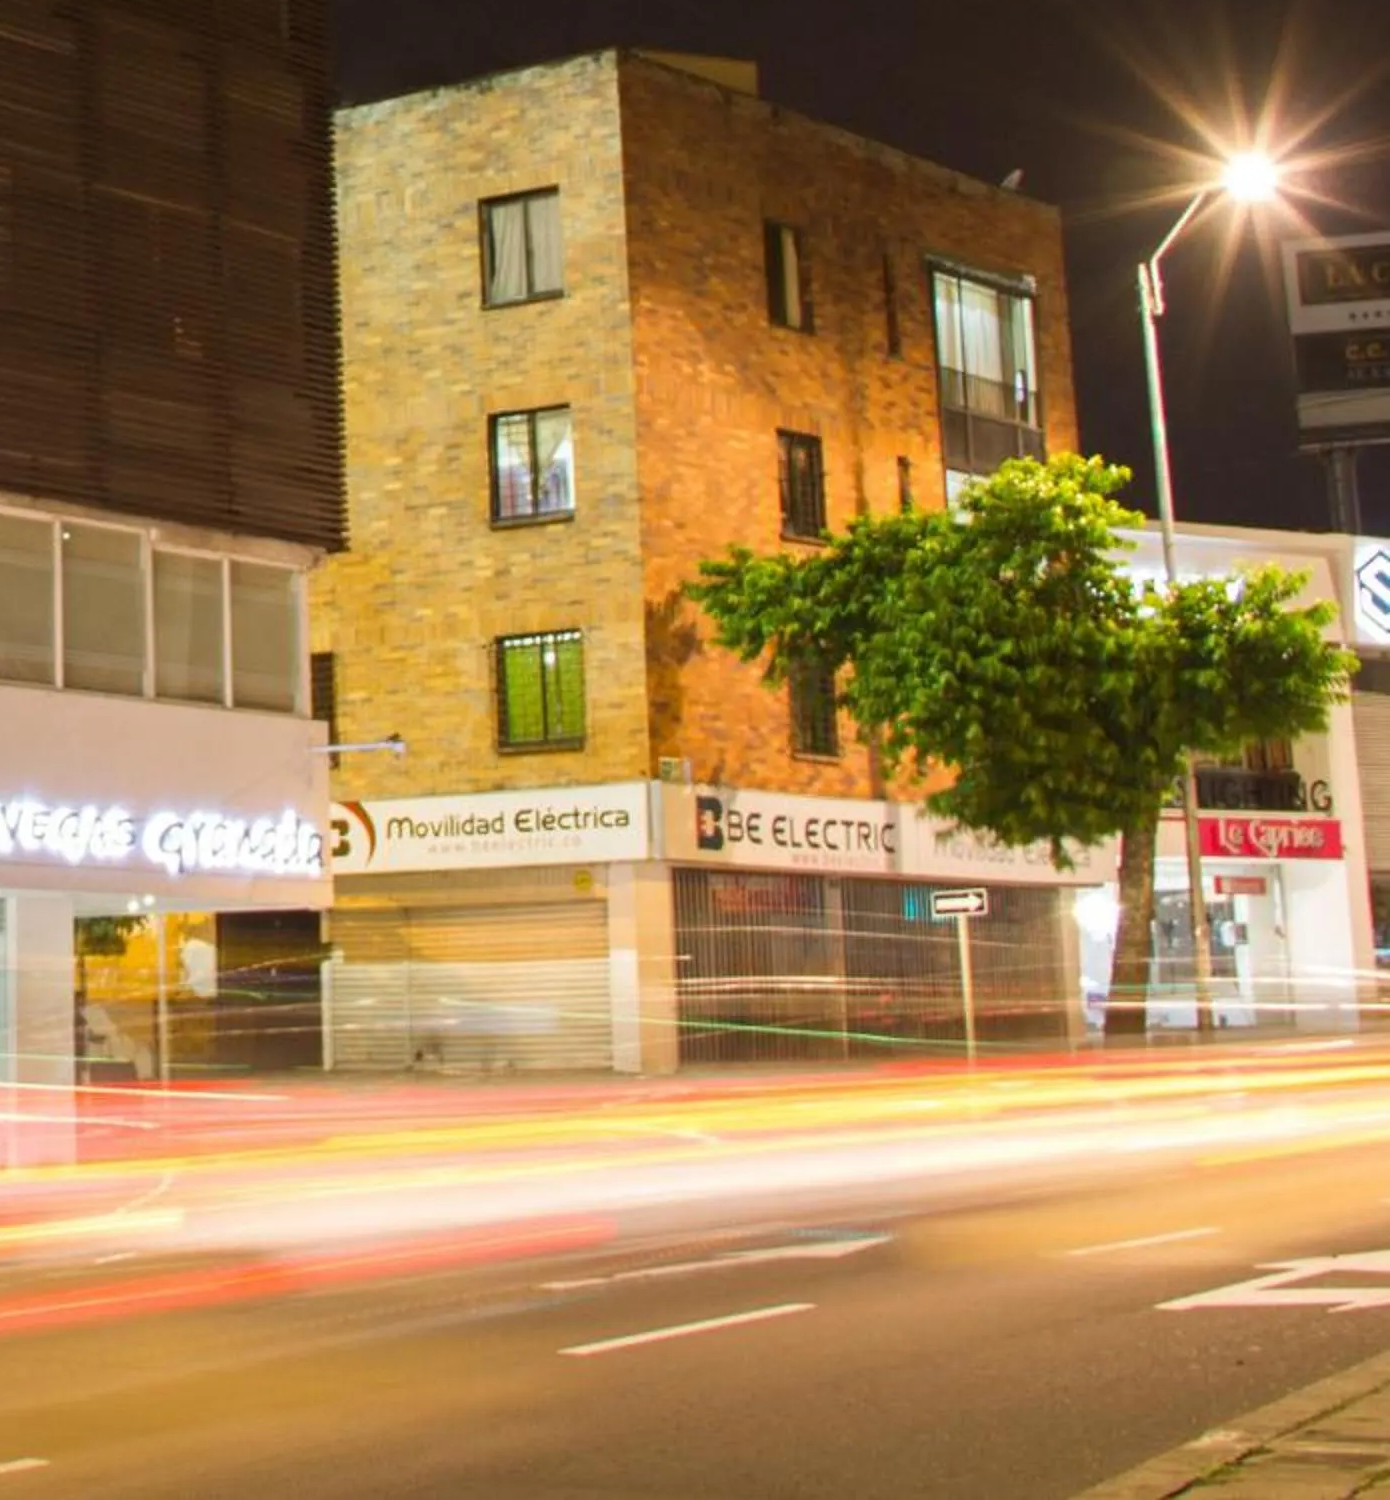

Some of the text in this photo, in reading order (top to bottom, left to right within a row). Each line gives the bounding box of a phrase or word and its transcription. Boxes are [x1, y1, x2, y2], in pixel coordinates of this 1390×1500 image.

[386, 805, 630, 840] Movilidad Eléctrica
[727, 809, 896, 853] BE ELECTRIC
